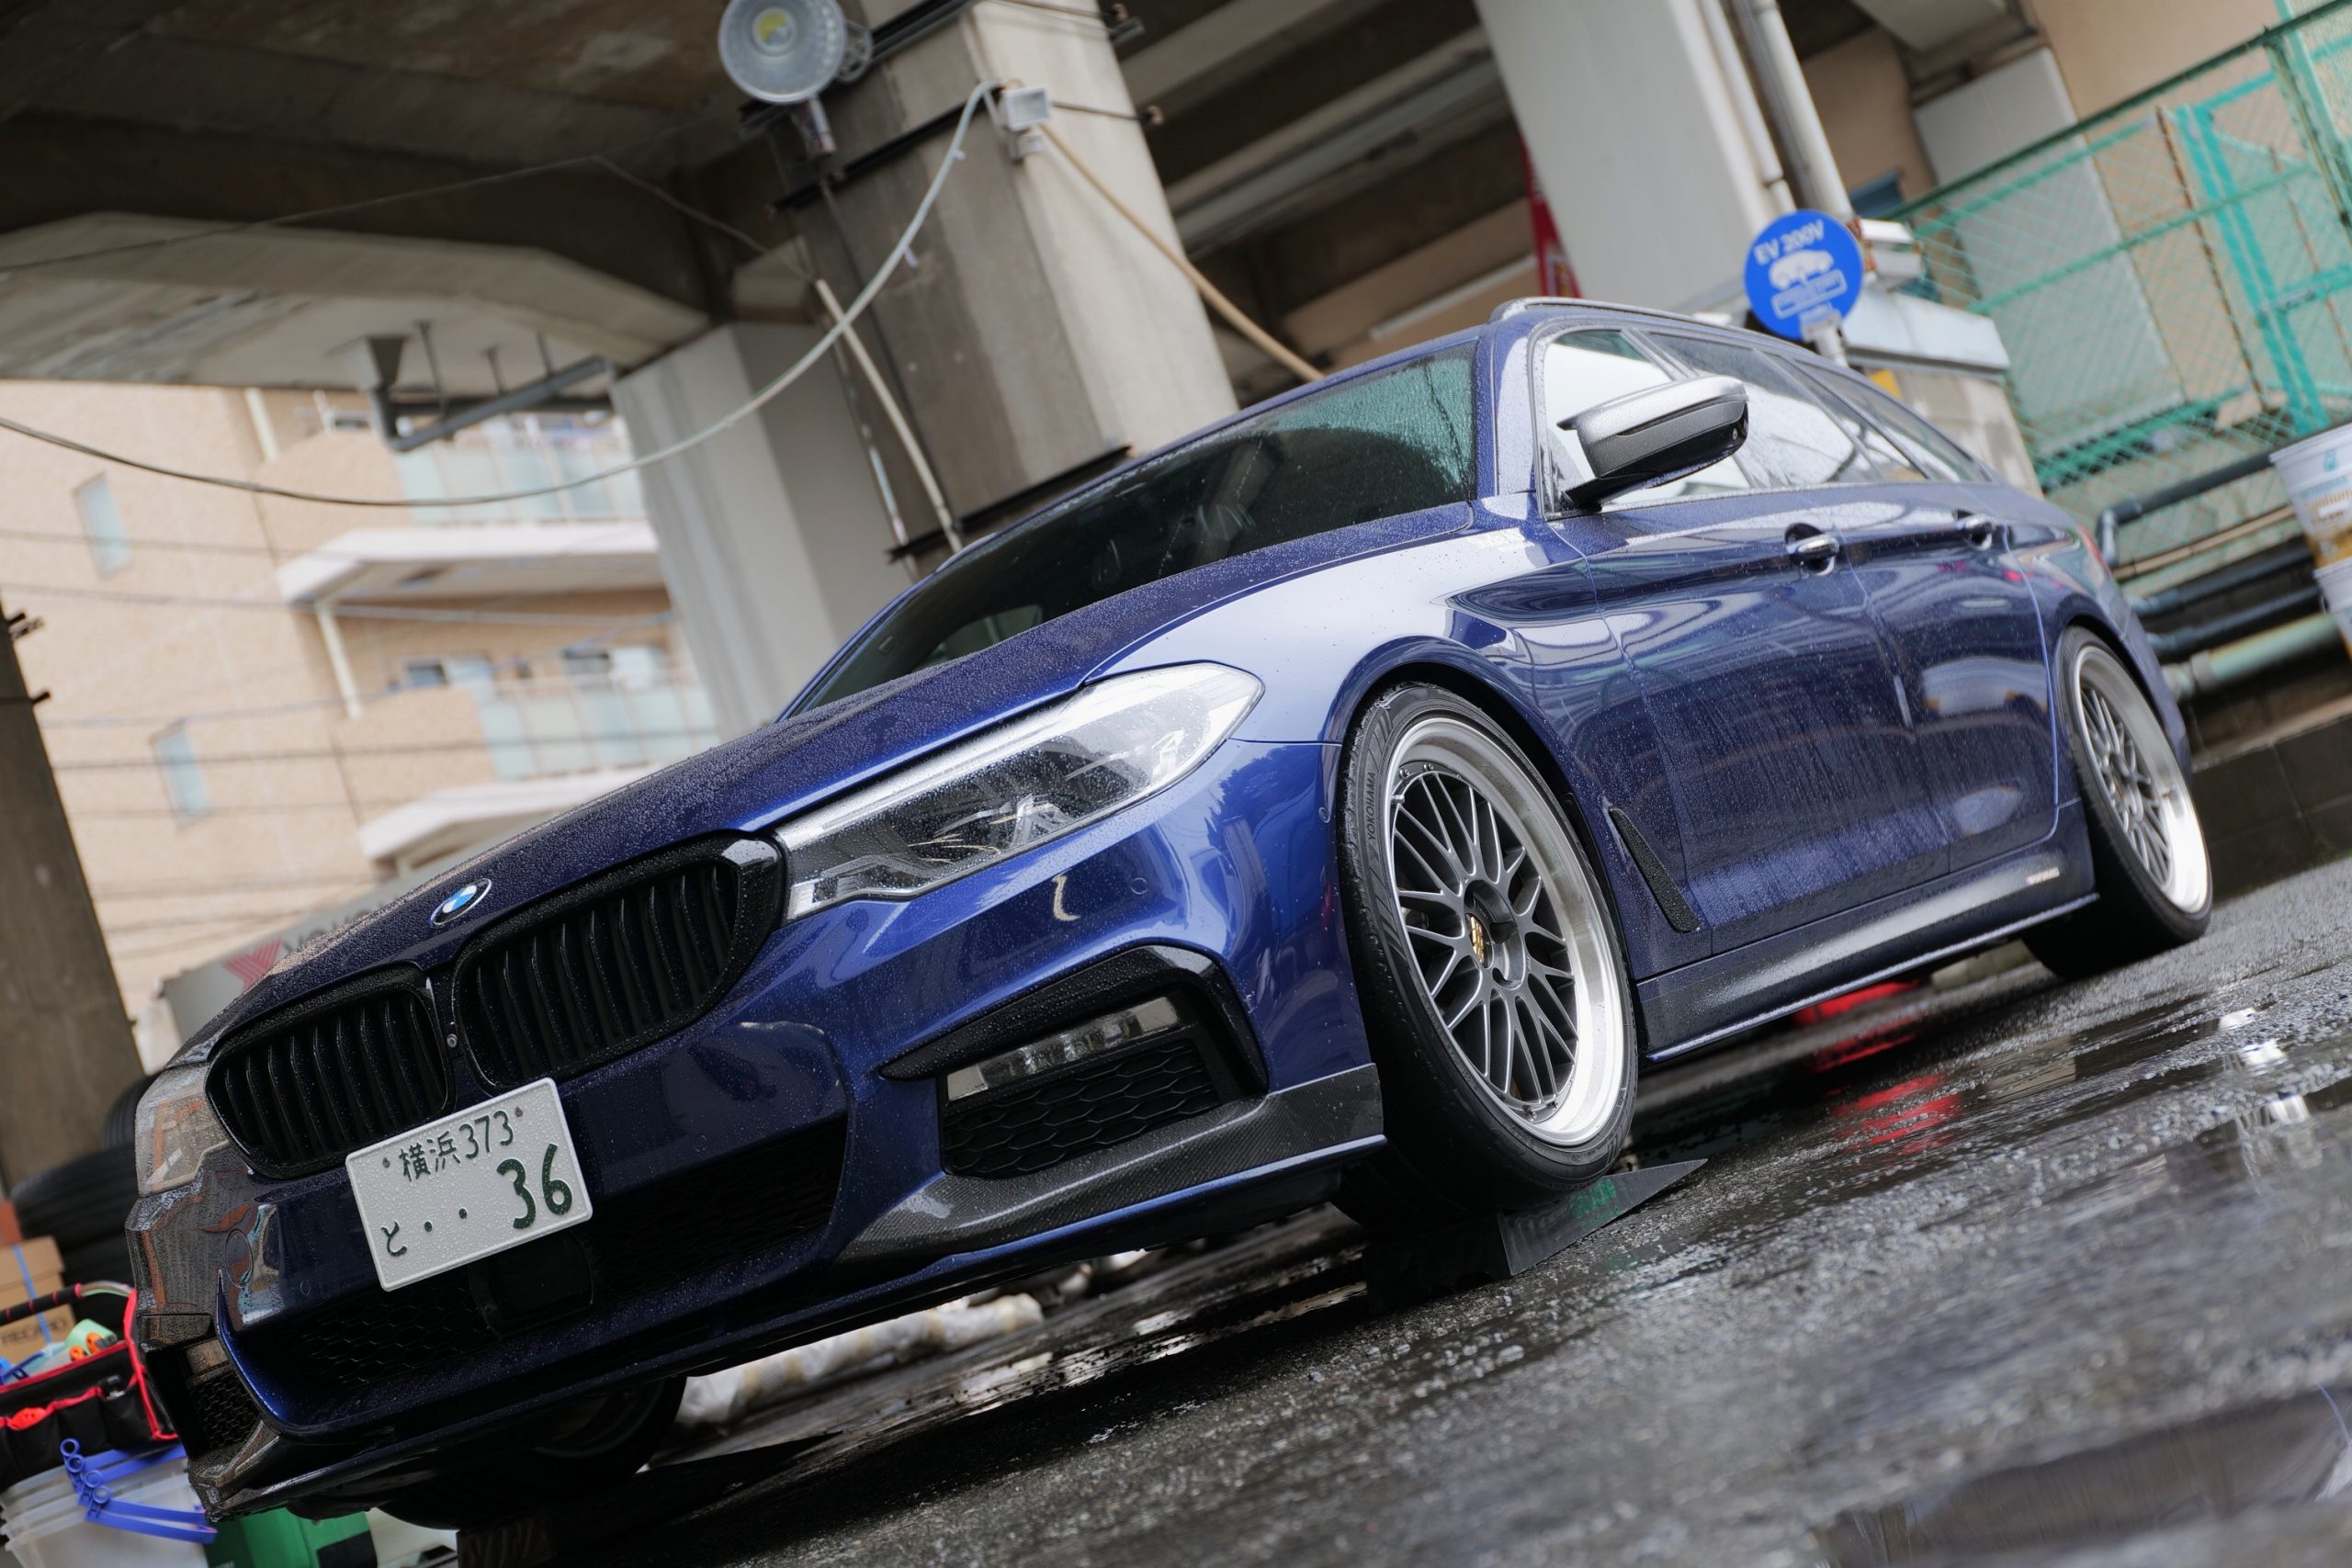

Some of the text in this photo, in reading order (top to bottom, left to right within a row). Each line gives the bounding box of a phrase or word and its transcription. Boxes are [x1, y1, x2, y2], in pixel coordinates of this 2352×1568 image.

[1754, 219, 1825, 265] EV 200V
[1365, 771, 1376, 841] YOKOHAMA
